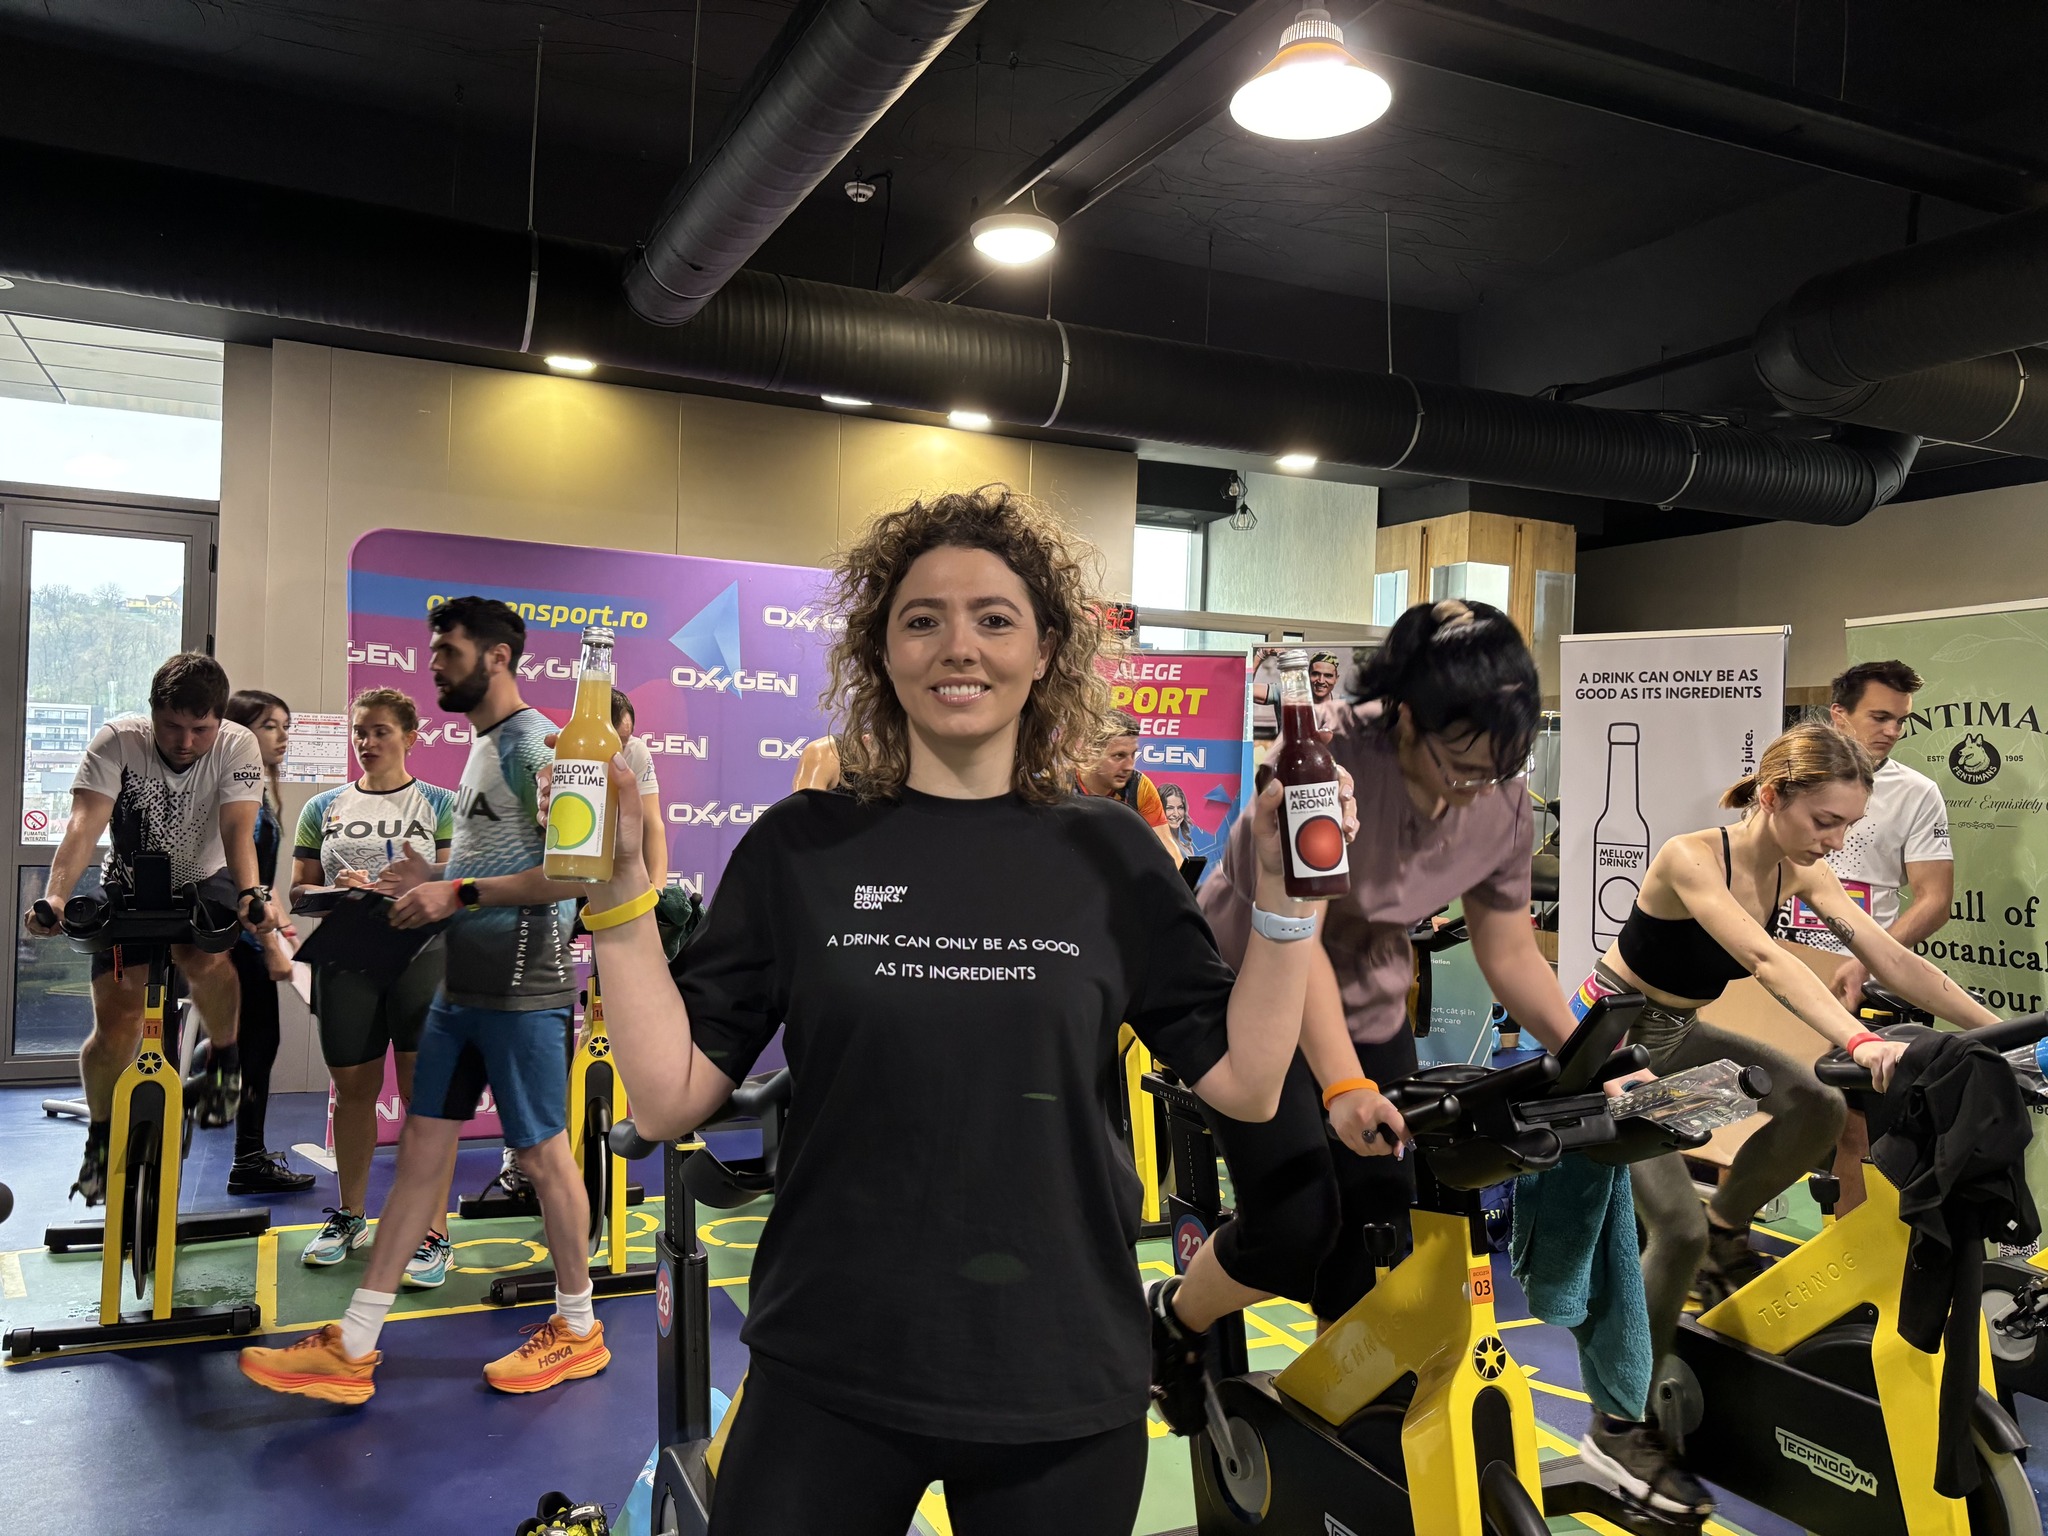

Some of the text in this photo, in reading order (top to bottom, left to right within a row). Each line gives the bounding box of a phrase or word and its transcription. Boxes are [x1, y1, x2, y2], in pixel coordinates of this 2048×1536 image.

[347, 642, 415, 672] GEN
[672, 667, 797, 696] OXYGEN
[1579, 669, 1758, 684] A DRINK CAN ONLY BE AS
[1111, 686, 1208, 715] PORT
[1575, 686, 1762, 700] GOOD AS ITS INGREDIENTS
[1139, 718, 1181, 736] EGE
[644, 734, 707, 758] GEN
[1742, 729, 1755, 764] juice.
[578, 776, 605, 787] LIME
[1952, 765, 1997, 783] FENTIMANS
[1290, 787, 1335, 800] MELLOW
[1291, 798, 1334, 810] ARONIA
[1979, 795, 2043, 814] Exquisitely
[325, 819, 429, 841] ROUA
[1600, 849, 1644, 860] MELLOW
[1600, 858, 1637, 868] DRINKS
[854, 893, 903, 903] DRINKS.
[855, 885, 908, 895] MELLOW
[853, 901, 883, 910] COM
[1949, 890, 2040, 927] ull of
[511, 921, 529, 987] TRIATHLON
[551, 920, 567, 983] TRIATHLON
[827, 934, 1080, 957] A DRINK CAN ONLY BE AS GOOD
[875, 962, 1036, 981] AS ITS INGREDIENTS
[147, 1026, 158, 1034] 11
[1474, 1280, 1491, 1296] 03
[658, 1281, 669, 1316] 23
[538, 1345, 573, 1369] HOKA
[1777, 1431, 1874, 1489] TECHNOGYM
